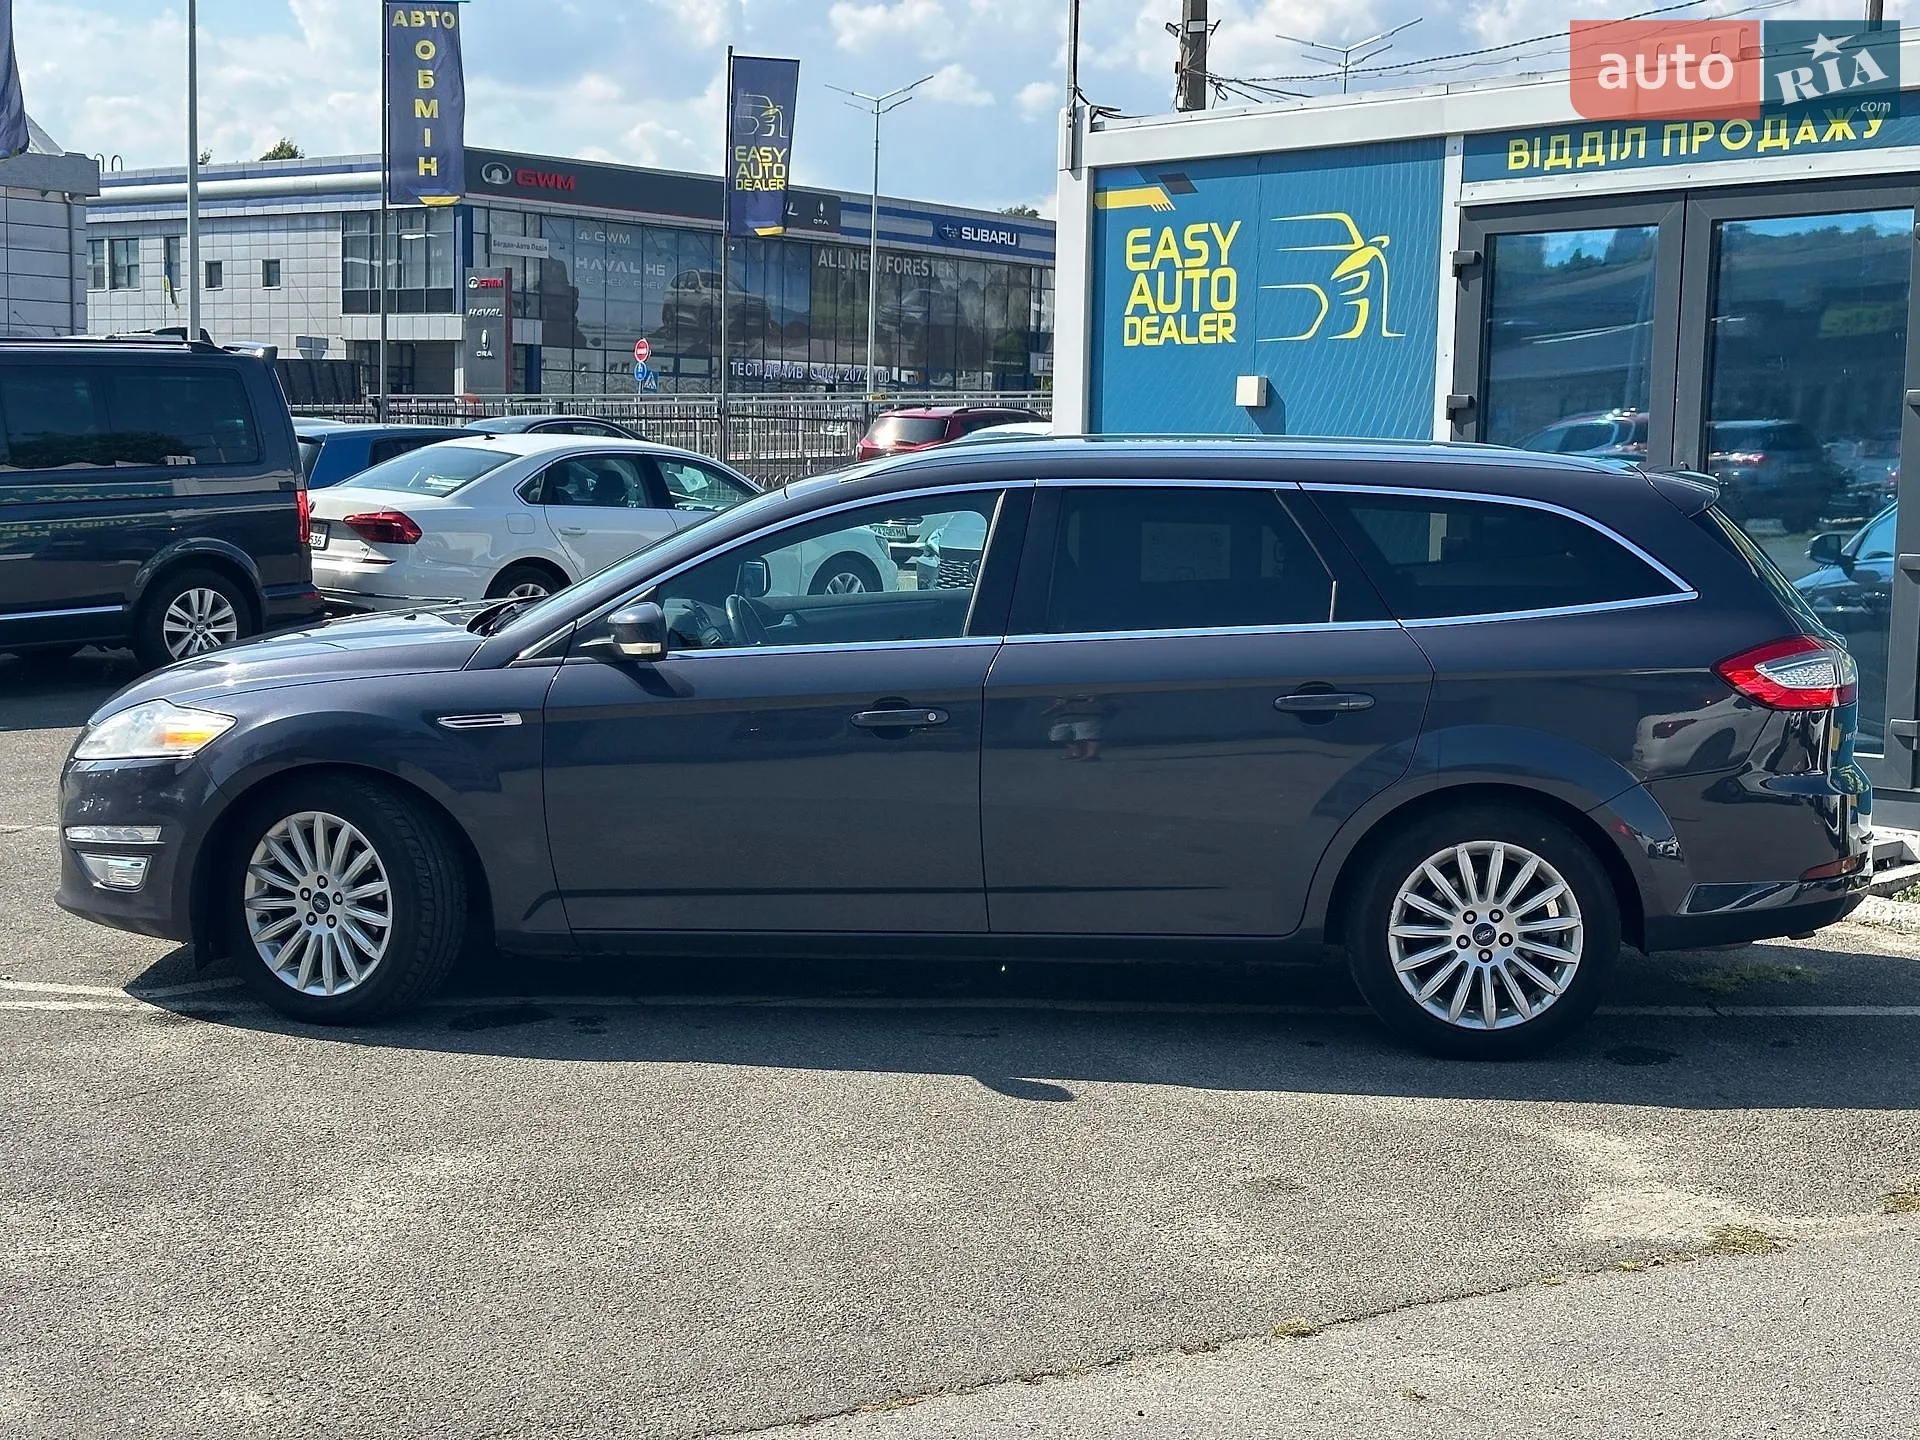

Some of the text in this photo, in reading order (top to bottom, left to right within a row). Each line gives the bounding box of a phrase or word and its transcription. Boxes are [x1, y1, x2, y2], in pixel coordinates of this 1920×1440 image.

[392, 10, 456, 30] АВТО
[415, 40, 439, 177] ОБМІН
[1508, 107, 1886, 171] ВІДДІЛ ПРОДАЖУ
[734, 145, 788, 163] EASY
[515, 168, 577, 191] GWM
[736, 163, 786, 179] AUTO
[736, 179, 786, 192] DEALER
[594, 231, 631, 245] GWM
[961, 226, 1017, 246] SUBARU
[1125, 220, 1242, 271] EASY
[575, 256, 666, 277] HAVAL H6
[818, 249, 846, 269] ALL
[1124, 266, 1238, 315] AUTO
[469, 308, 503, 318] HAVAL
[1123, 312, 1237, 347] DEALER
[730, 361, 804, 380] ТЕСТ-ДРАЙВ
